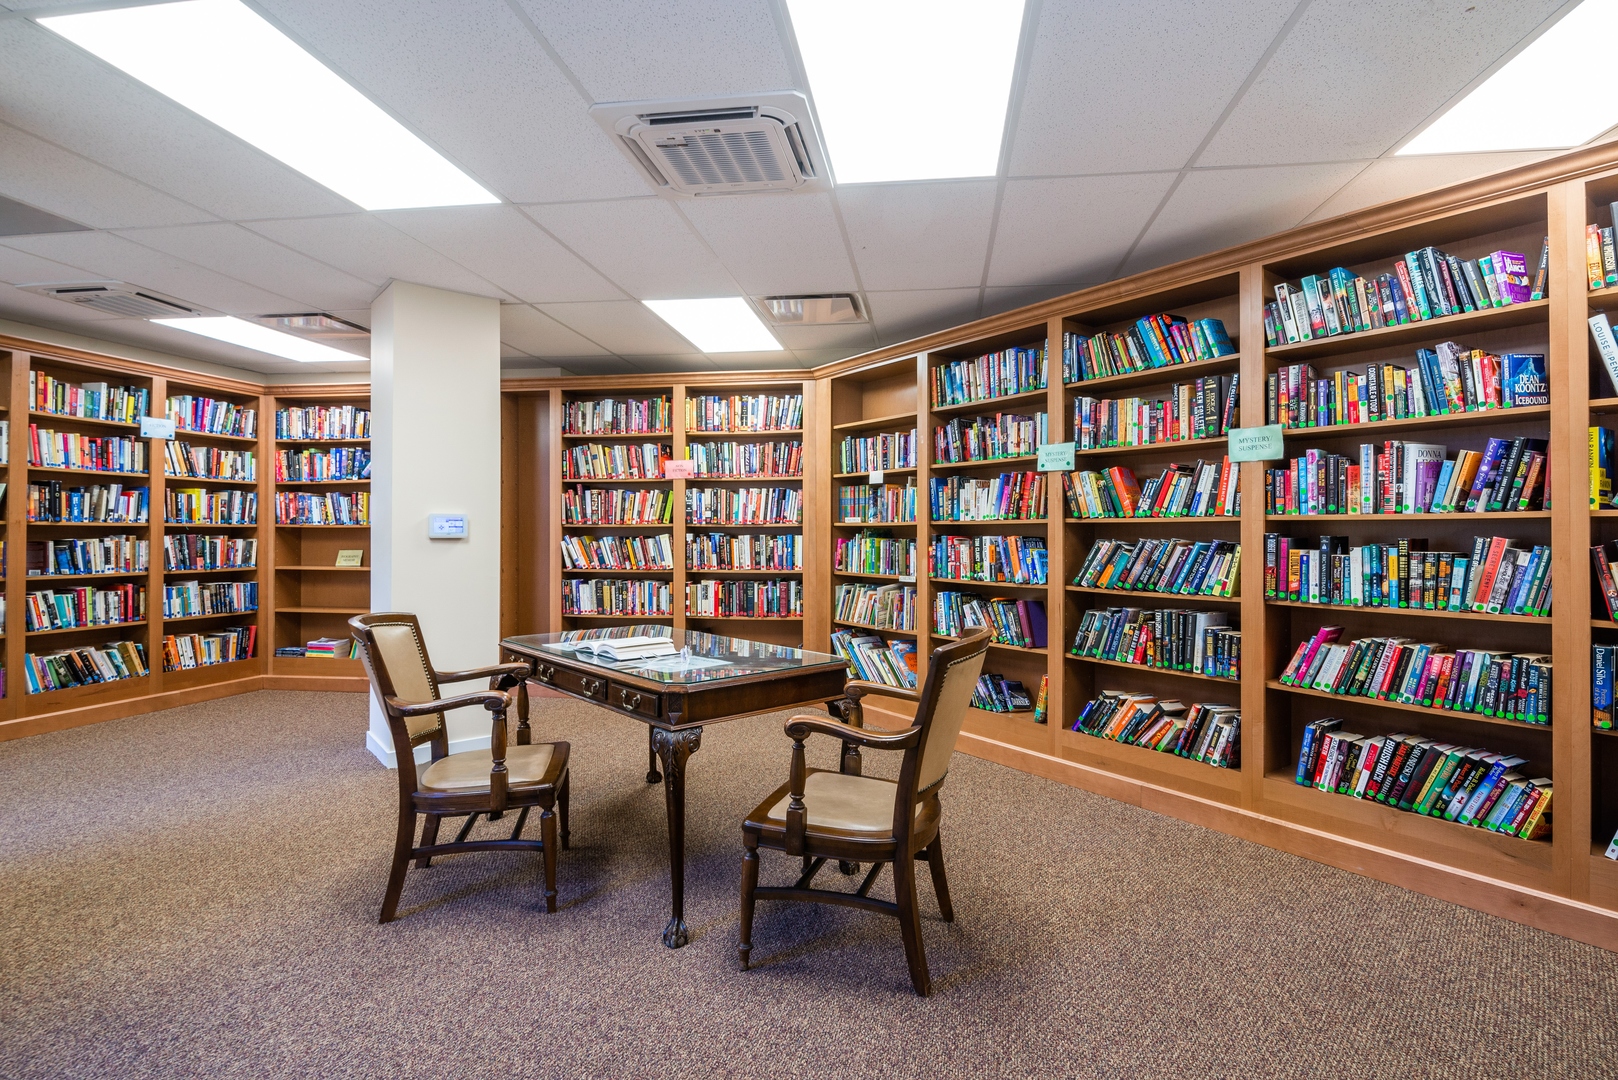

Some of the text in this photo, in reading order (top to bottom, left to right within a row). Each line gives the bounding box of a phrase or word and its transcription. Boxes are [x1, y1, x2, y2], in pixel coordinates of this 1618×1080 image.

[1415, 268, 1423, 287] JAMES
[1593, 322, 1610, 350] LOUISE
[1368, 367, 1376, 393] CONSTABLE
[1515, 384, 1546, 392] KOONTZ
[1520, 375, 1539, 384] DEAN
[1228, 385, 1236, 406] FOLLETT
[1516, 394, 1548, 404] ICEBOUND
[1238, 444, 1272, 452] SUSPENSE
[1418, 450, 1442, 458] DONNA
[1399, 540, 1407, 554] STEVE
[1126, 549, 1148, 584] Elizabeth George
[1399, 556, 1407, 577] MARTINI
[1483, 538, 1502, 587] THE SECRET AGENT
[1596, 649, 1605, 685] Daniel Silva
[1372, 739, 1396, 781] BRUSH BACK
[1397, 744, 1408, 756] SARA
[1412, 745, 1423, 757] SARA
[1466, 789, 1484, 814] PAINTED LADIES
